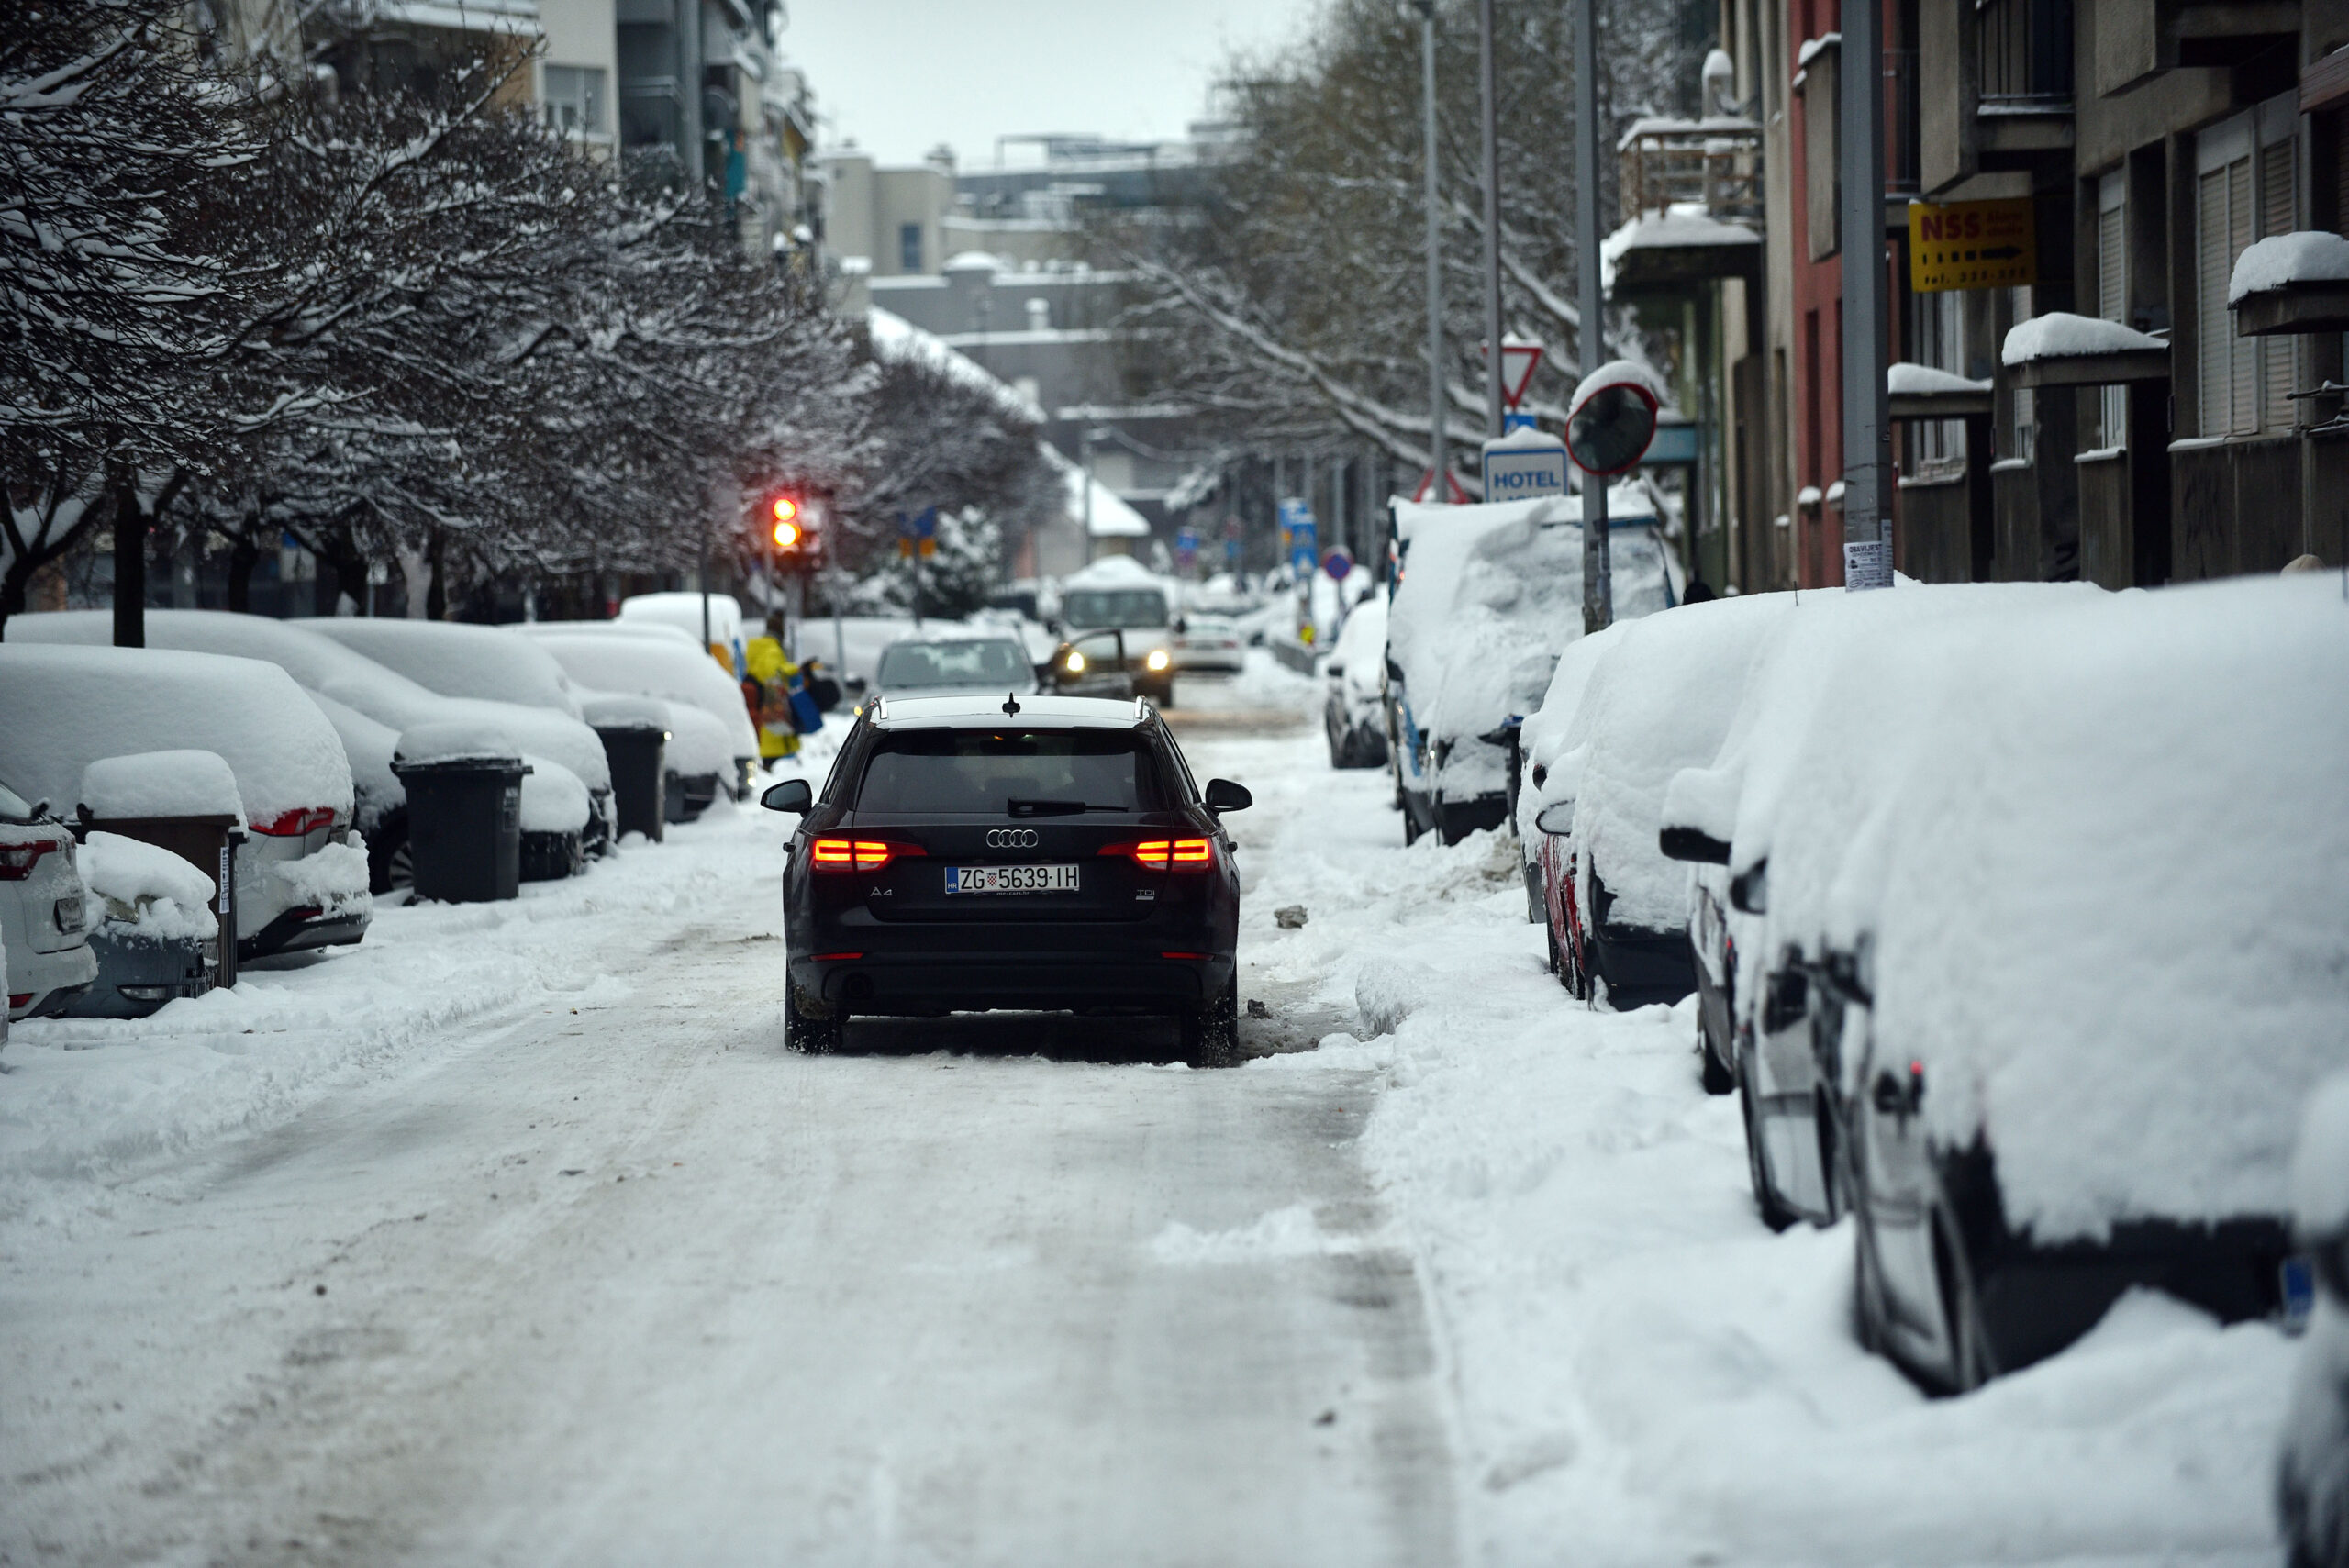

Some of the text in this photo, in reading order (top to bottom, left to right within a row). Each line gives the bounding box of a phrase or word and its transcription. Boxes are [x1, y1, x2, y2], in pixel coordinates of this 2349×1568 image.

[1921, 211, 1980, 241] NSS
[1494, 471, 1561, 488] HOTEL
[961, 869, 985, 890] ZG
[870, 886, 893, 897] A4
